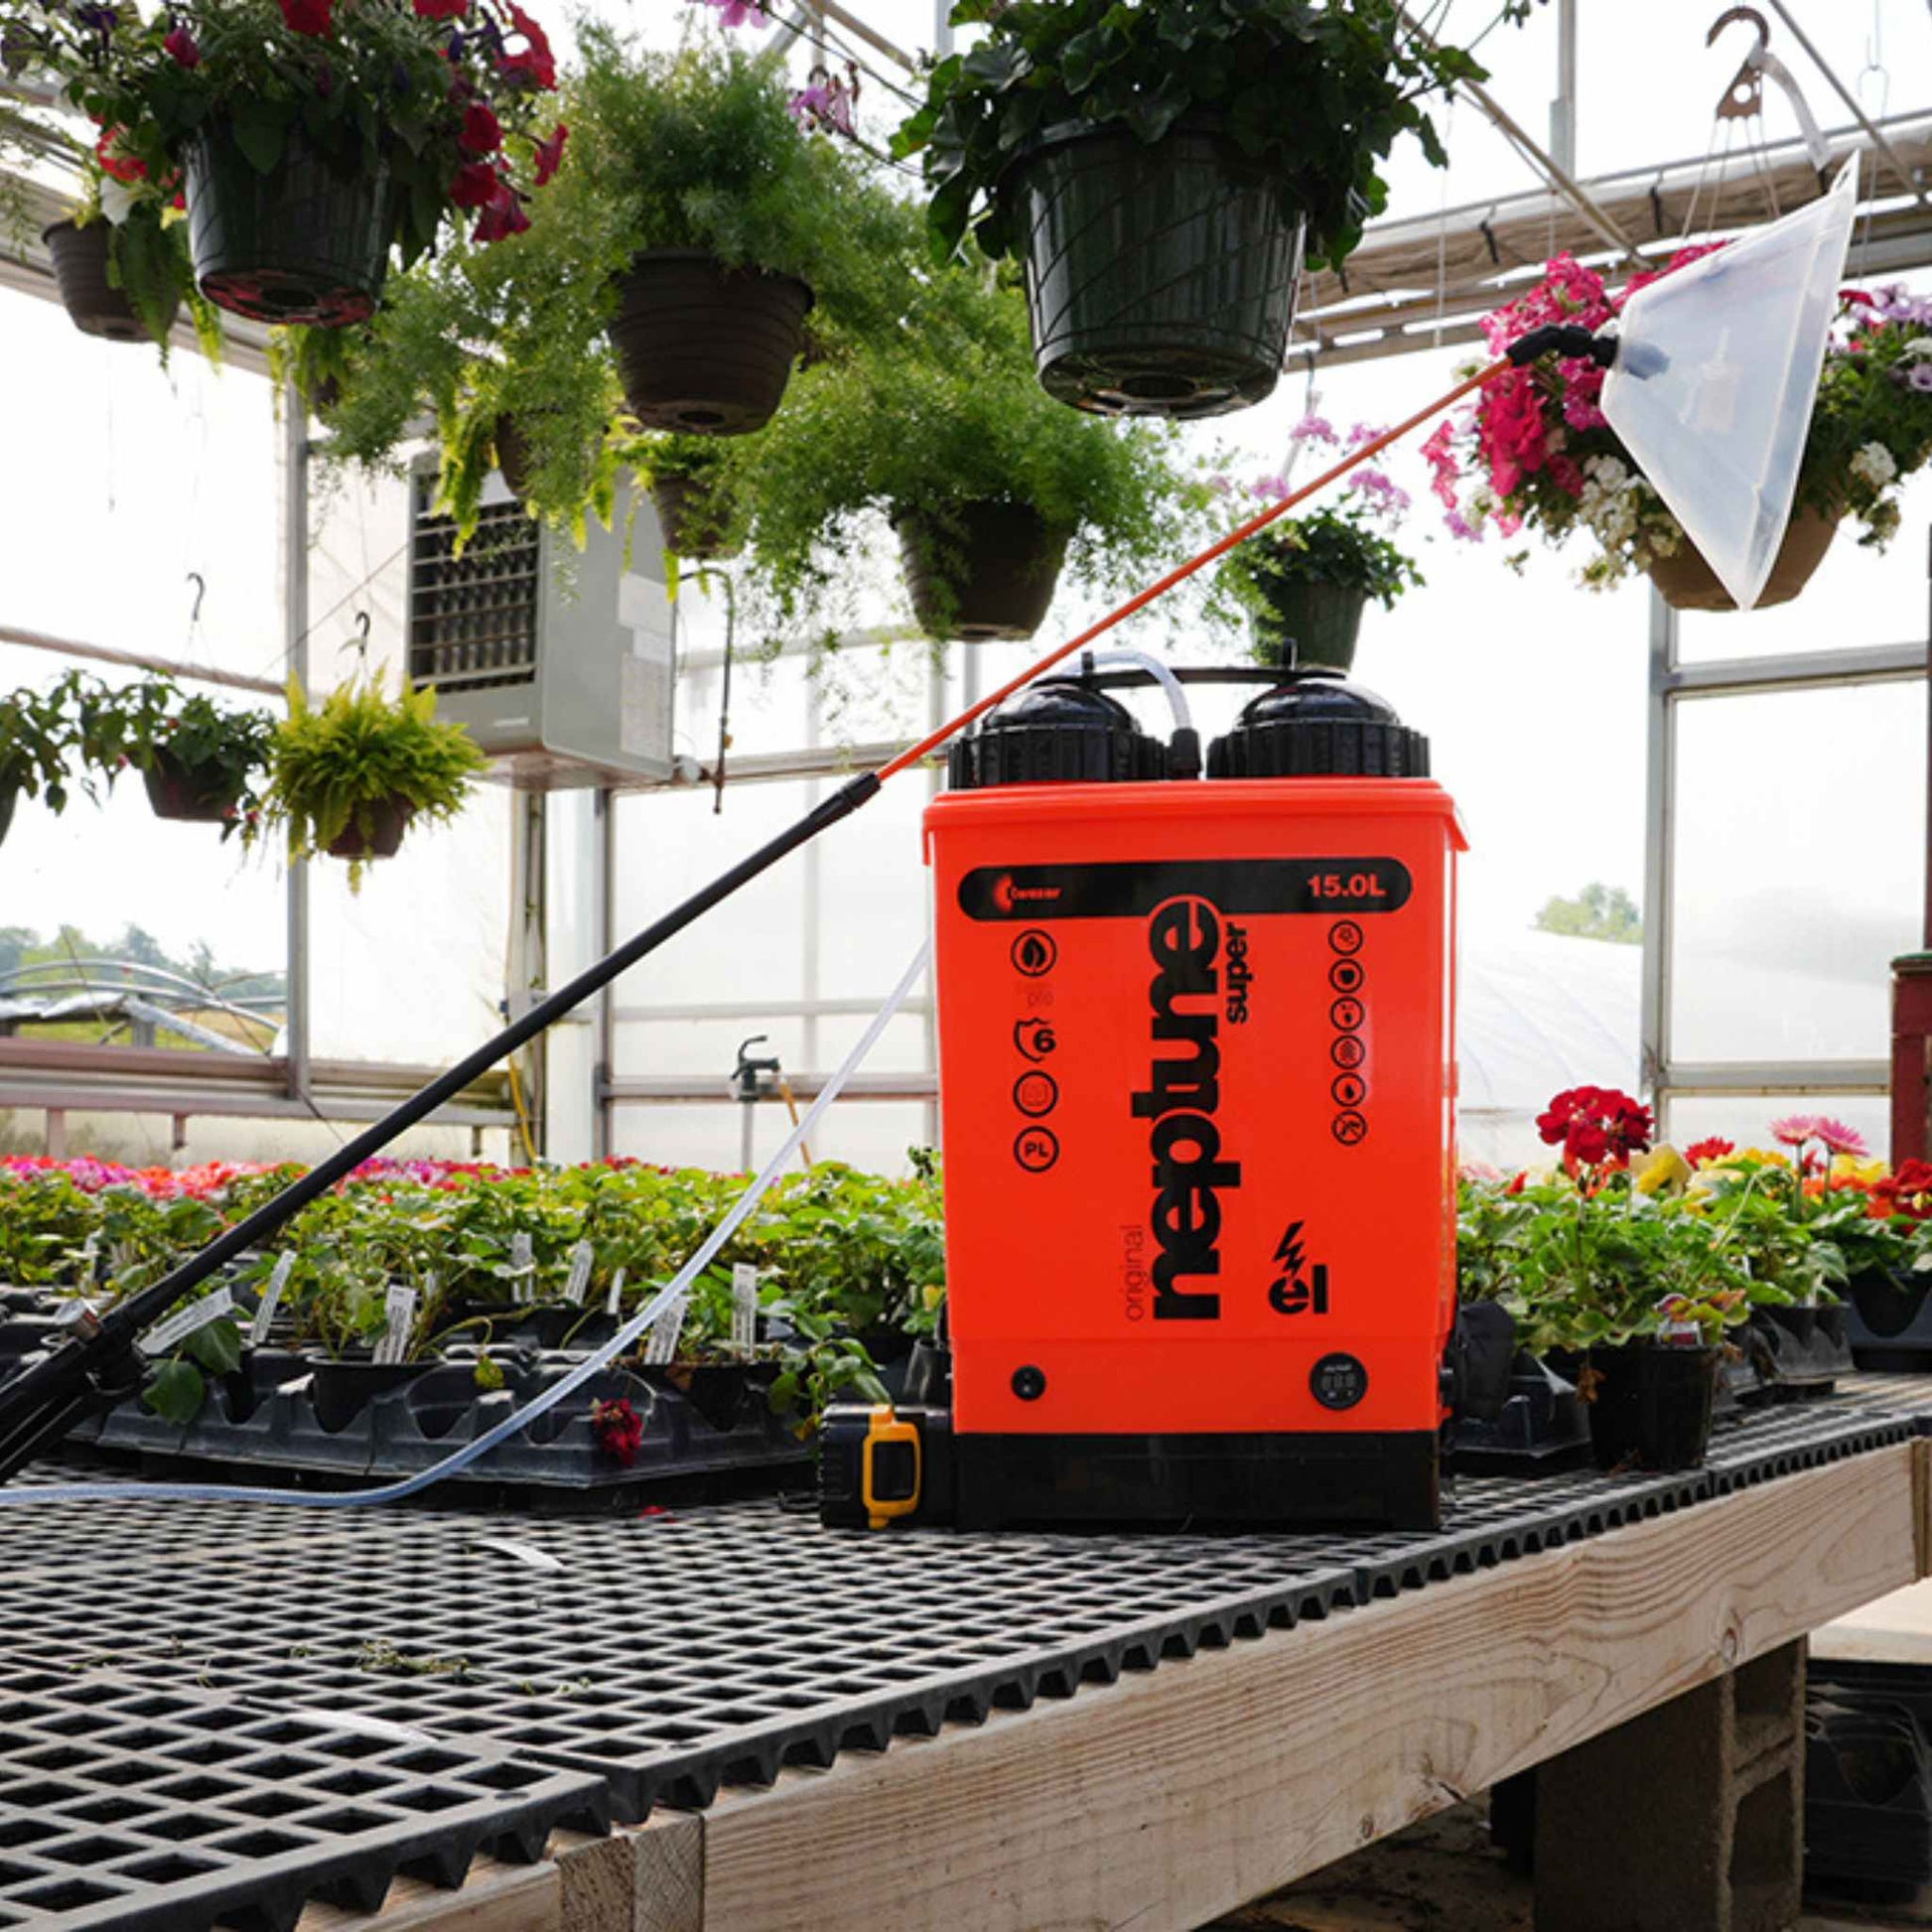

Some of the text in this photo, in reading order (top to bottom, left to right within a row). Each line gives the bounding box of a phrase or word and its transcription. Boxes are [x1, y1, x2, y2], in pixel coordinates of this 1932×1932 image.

[1308, 875, 1386, 897] 15.0L
[1226, 922, 1253, 1024] super
[1034, 1028, 1057, 1053] 6
[1131, 896, 1241, 1319] neptune
[1025, 1142, 1049, 1158] PL
[1119, 1224, 1147, 1321] original
